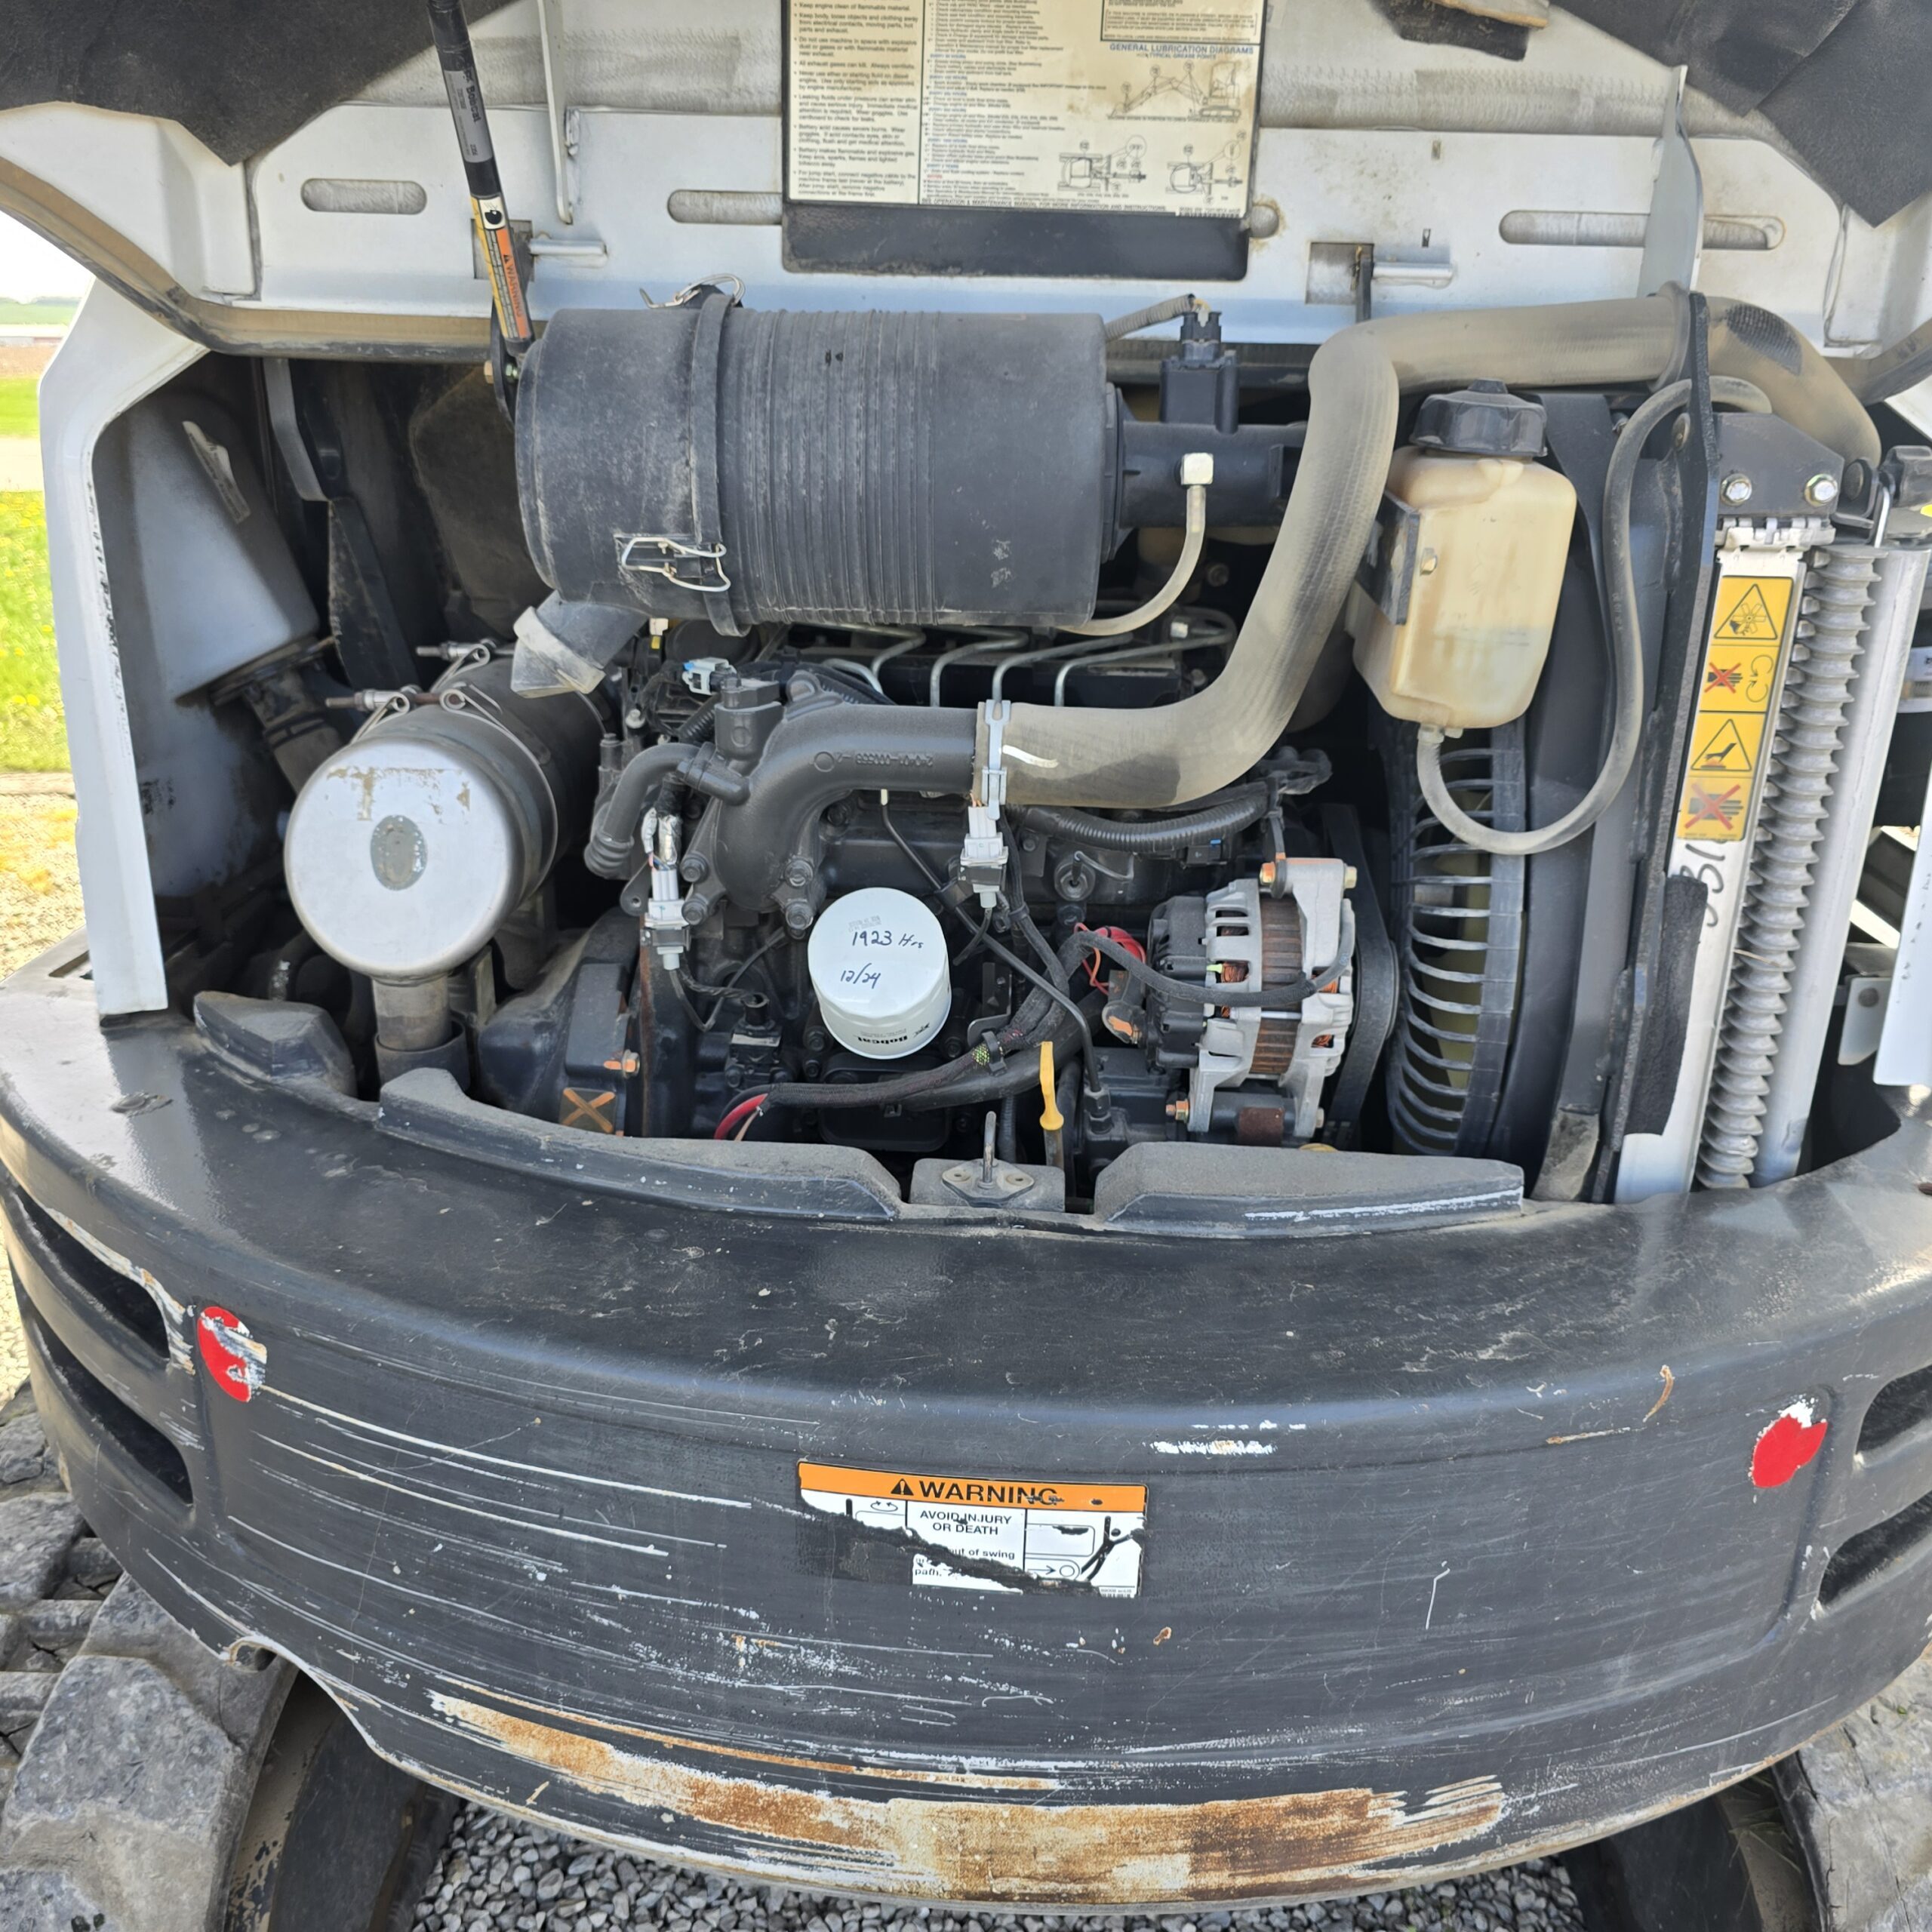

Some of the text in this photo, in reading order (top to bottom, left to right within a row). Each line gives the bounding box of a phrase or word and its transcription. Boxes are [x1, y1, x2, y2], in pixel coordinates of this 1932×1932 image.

[466, 85, 481, 123] Bobcat
[506, 261, 524, 317] WARNING
[852, 931, 892, 946] 1923
[841, 963, 881, 989] 12/24
[857, 1035, 908, 1044] Bobcat
[919, 1480, 1058, 1506] WARNING
[920, 1510, 1012, 1524] AVOID INJURY
[933, 1522, 998, 1535] OR DEATH
[968, 1548, 980, 1556] of
[983, 1549, 1015, 1560] swing
